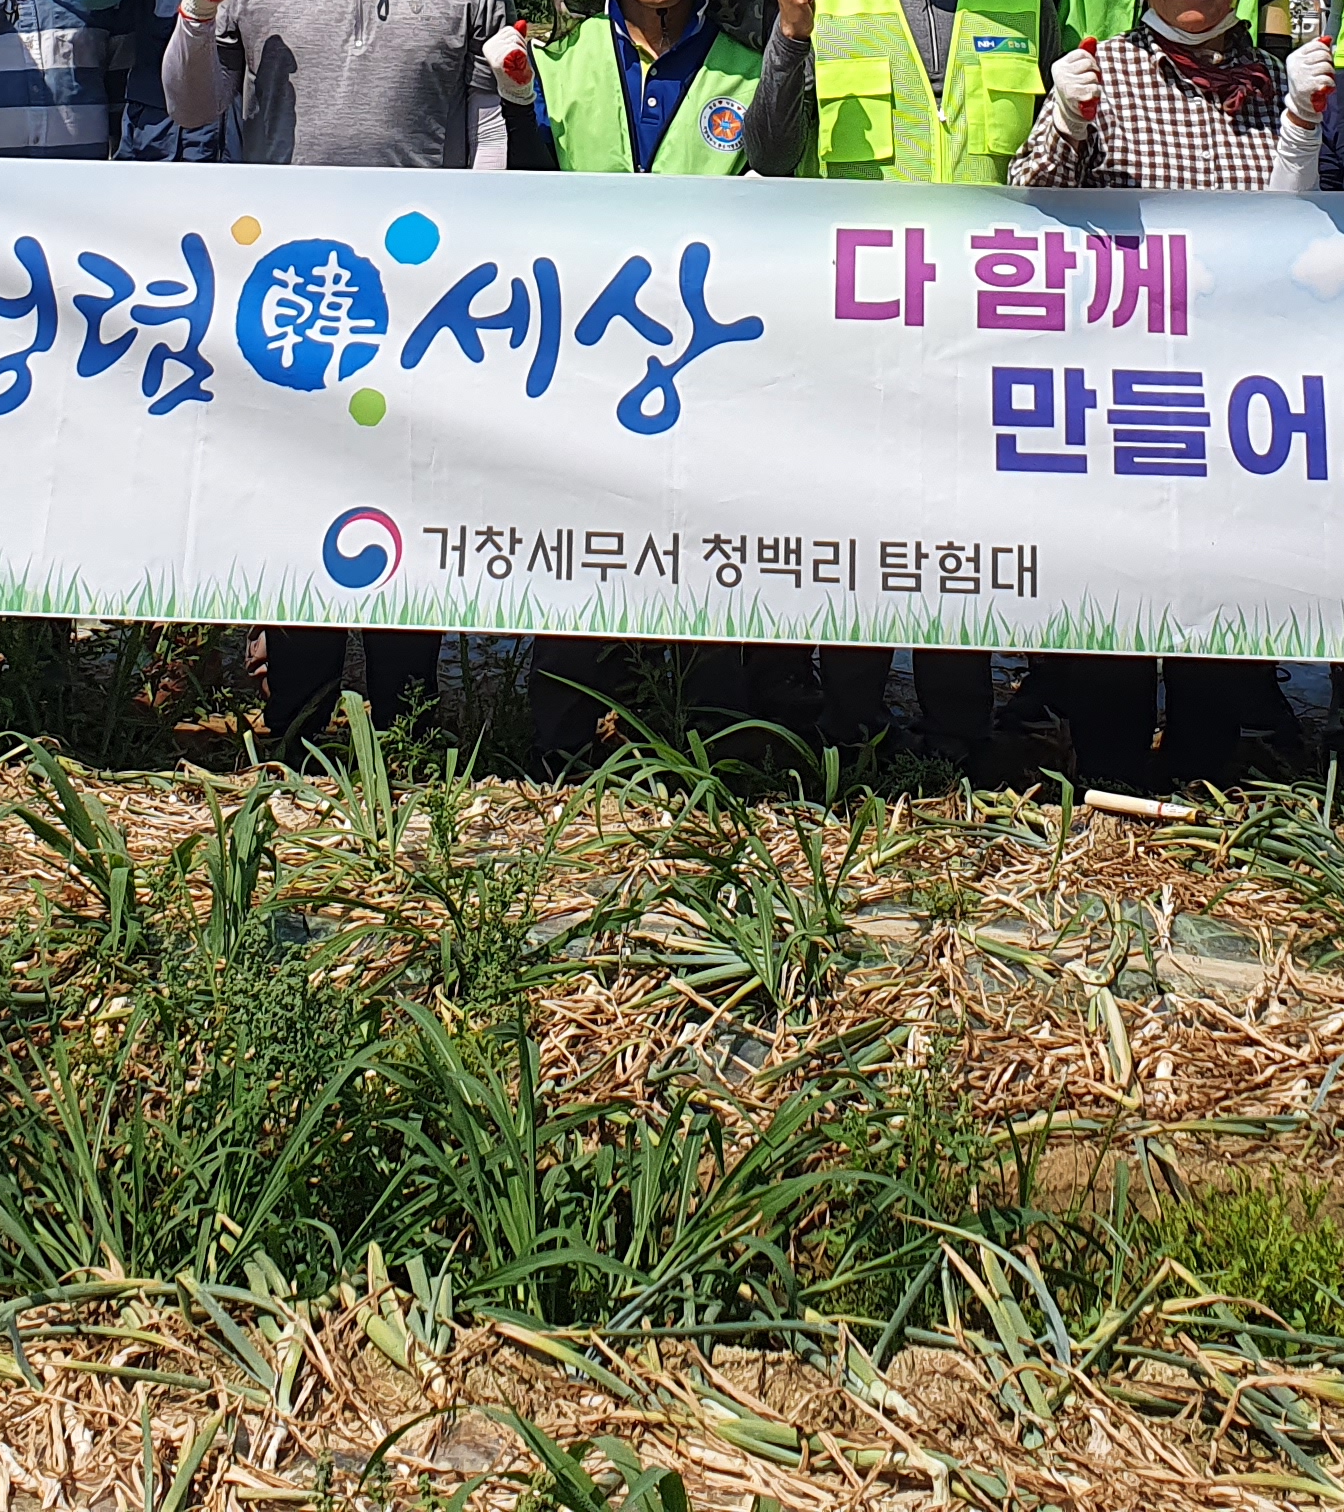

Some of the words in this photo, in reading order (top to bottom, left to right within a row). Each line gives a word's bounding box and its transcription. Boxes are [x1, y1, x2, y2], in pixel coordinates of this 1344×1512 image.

[977, 40, 995, 48] NH
[834, 228, 937, 328] 다
[970, 229, 1189, 338] 함께
[422, 525, 680, 585] 거창세무서
[702, 533, 856, 592] 청백리
[879, 541, 1038, 598] 탐험대
